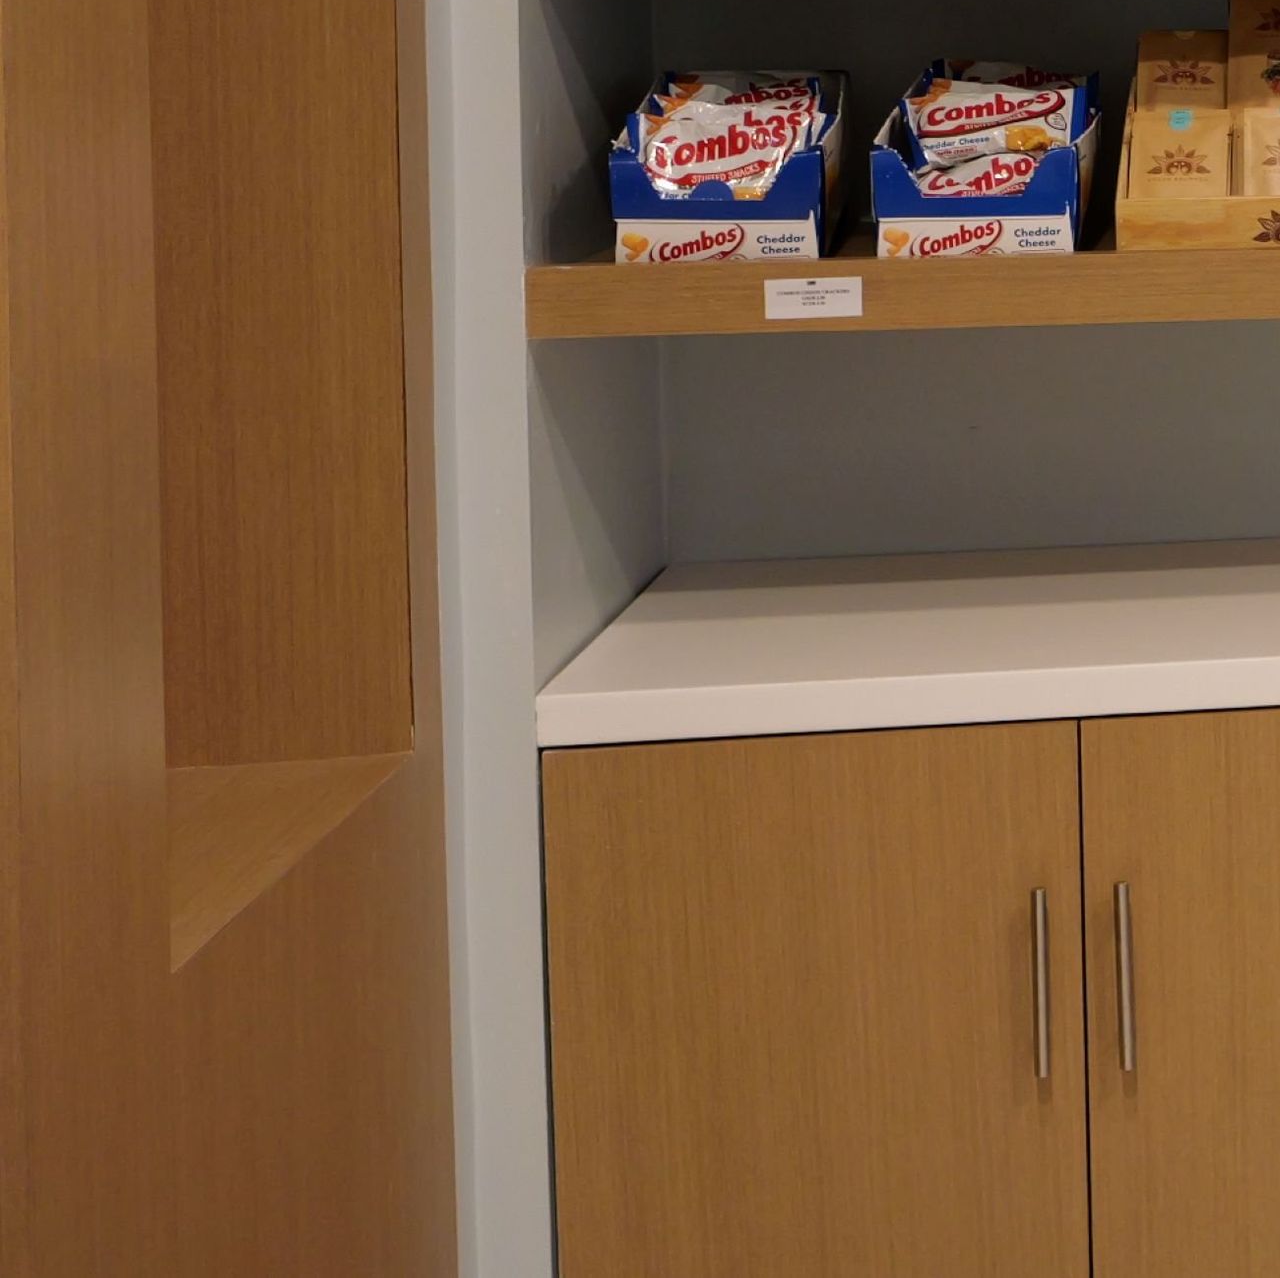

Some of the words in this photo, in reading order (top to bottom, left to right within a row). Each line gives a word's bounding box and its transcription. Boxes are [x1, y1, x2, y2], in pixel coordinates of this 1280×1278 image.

[926, 90, 1052, 127] Combos
[655, 124, 788, 169] Combos
[958, 135, 990, 147] Cheese
[728, 162, 760, 180] SNACKS
[756, 233, 806, 244] Cheddar
[919, 221, 995, 256] Combos
[1013, 226, 1062, 237] Cheddar
[658, 228, 738, 263] Combos
[761, 245, 801, 255] Cheese
[1018, 238, 1056, 248] Cheese
